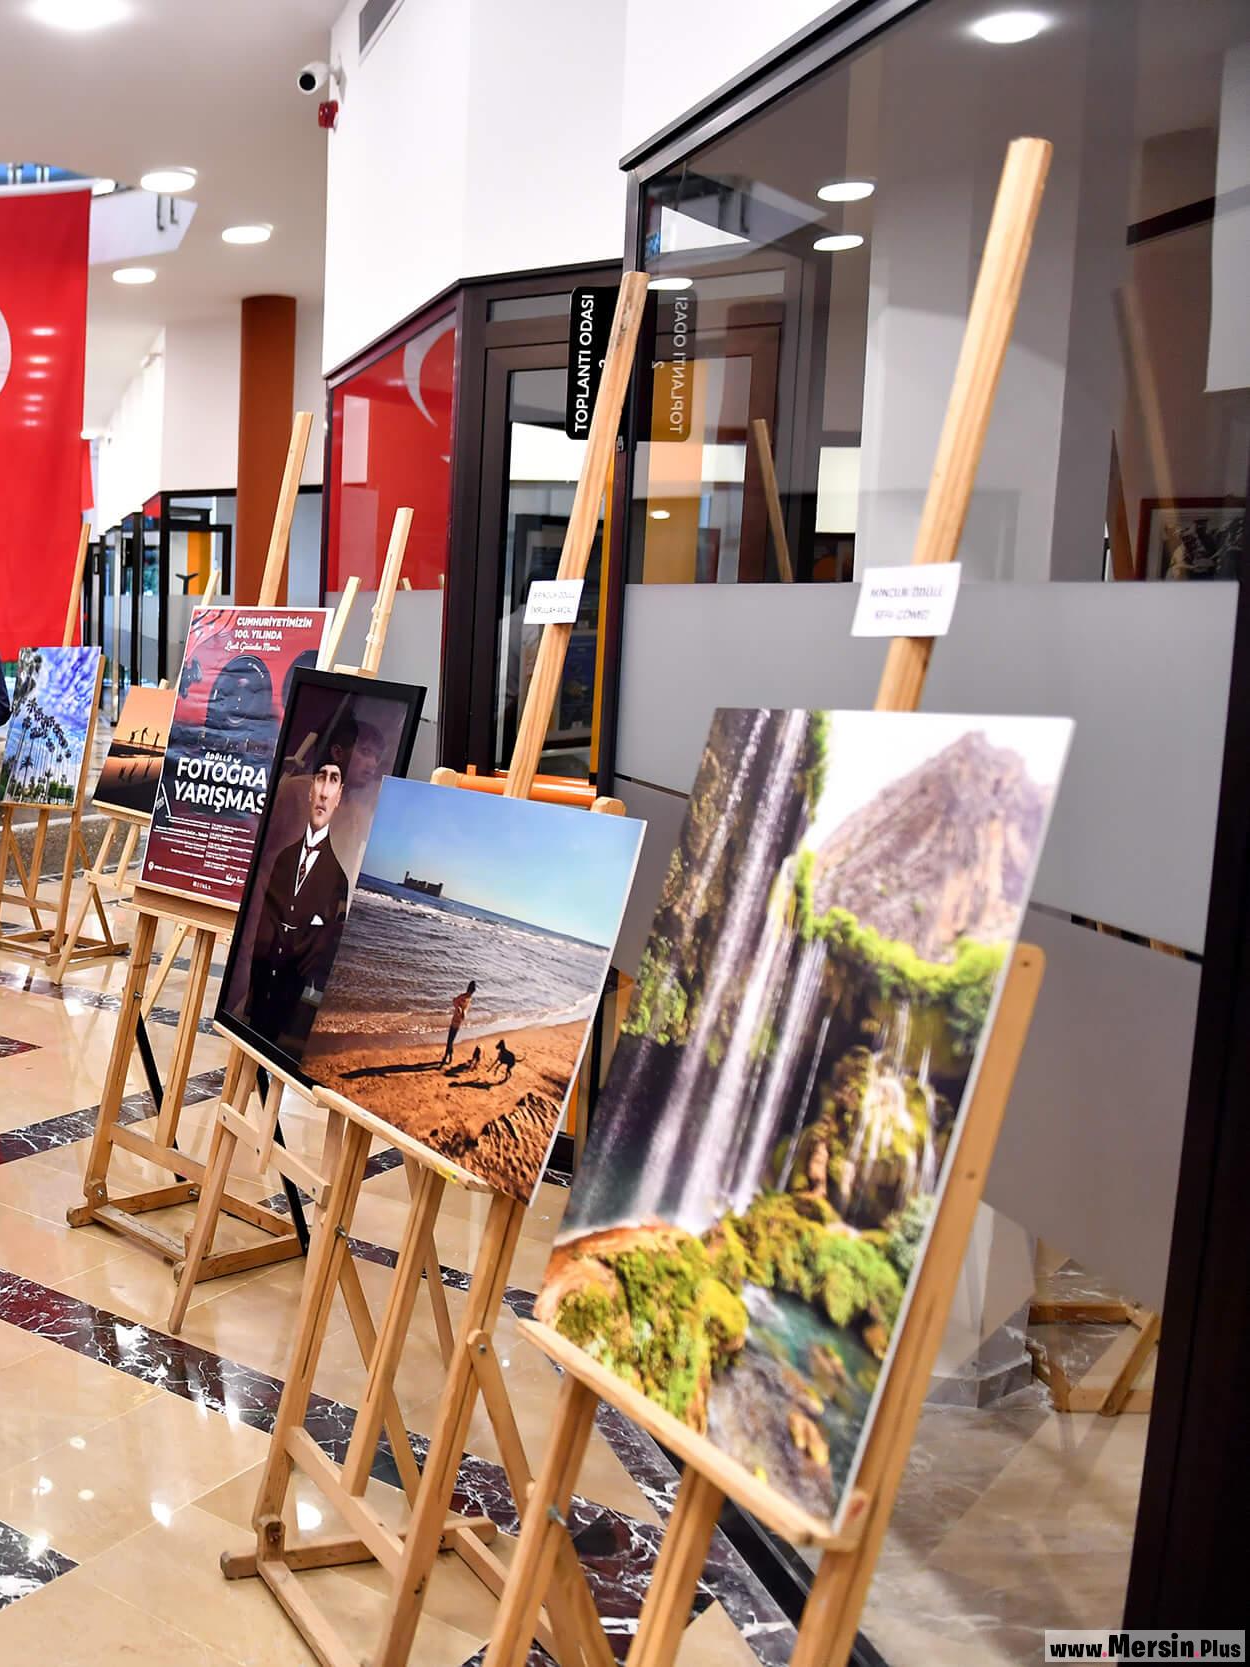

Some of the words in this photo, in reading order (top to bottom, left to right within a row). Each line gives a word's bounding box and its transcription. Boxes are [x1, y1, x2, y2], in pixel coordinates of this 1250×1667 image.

[579, 295, 594, 346] ODASI
[575, 350, 591, 432] TOPLANTI
[234, 629, 250, 639] 100.
[251, 629, 283, 641] YILINDA
[177, 756, 268, 790] FOTOĞRA
[174, 780, 267, 815] YARIŞMAS
